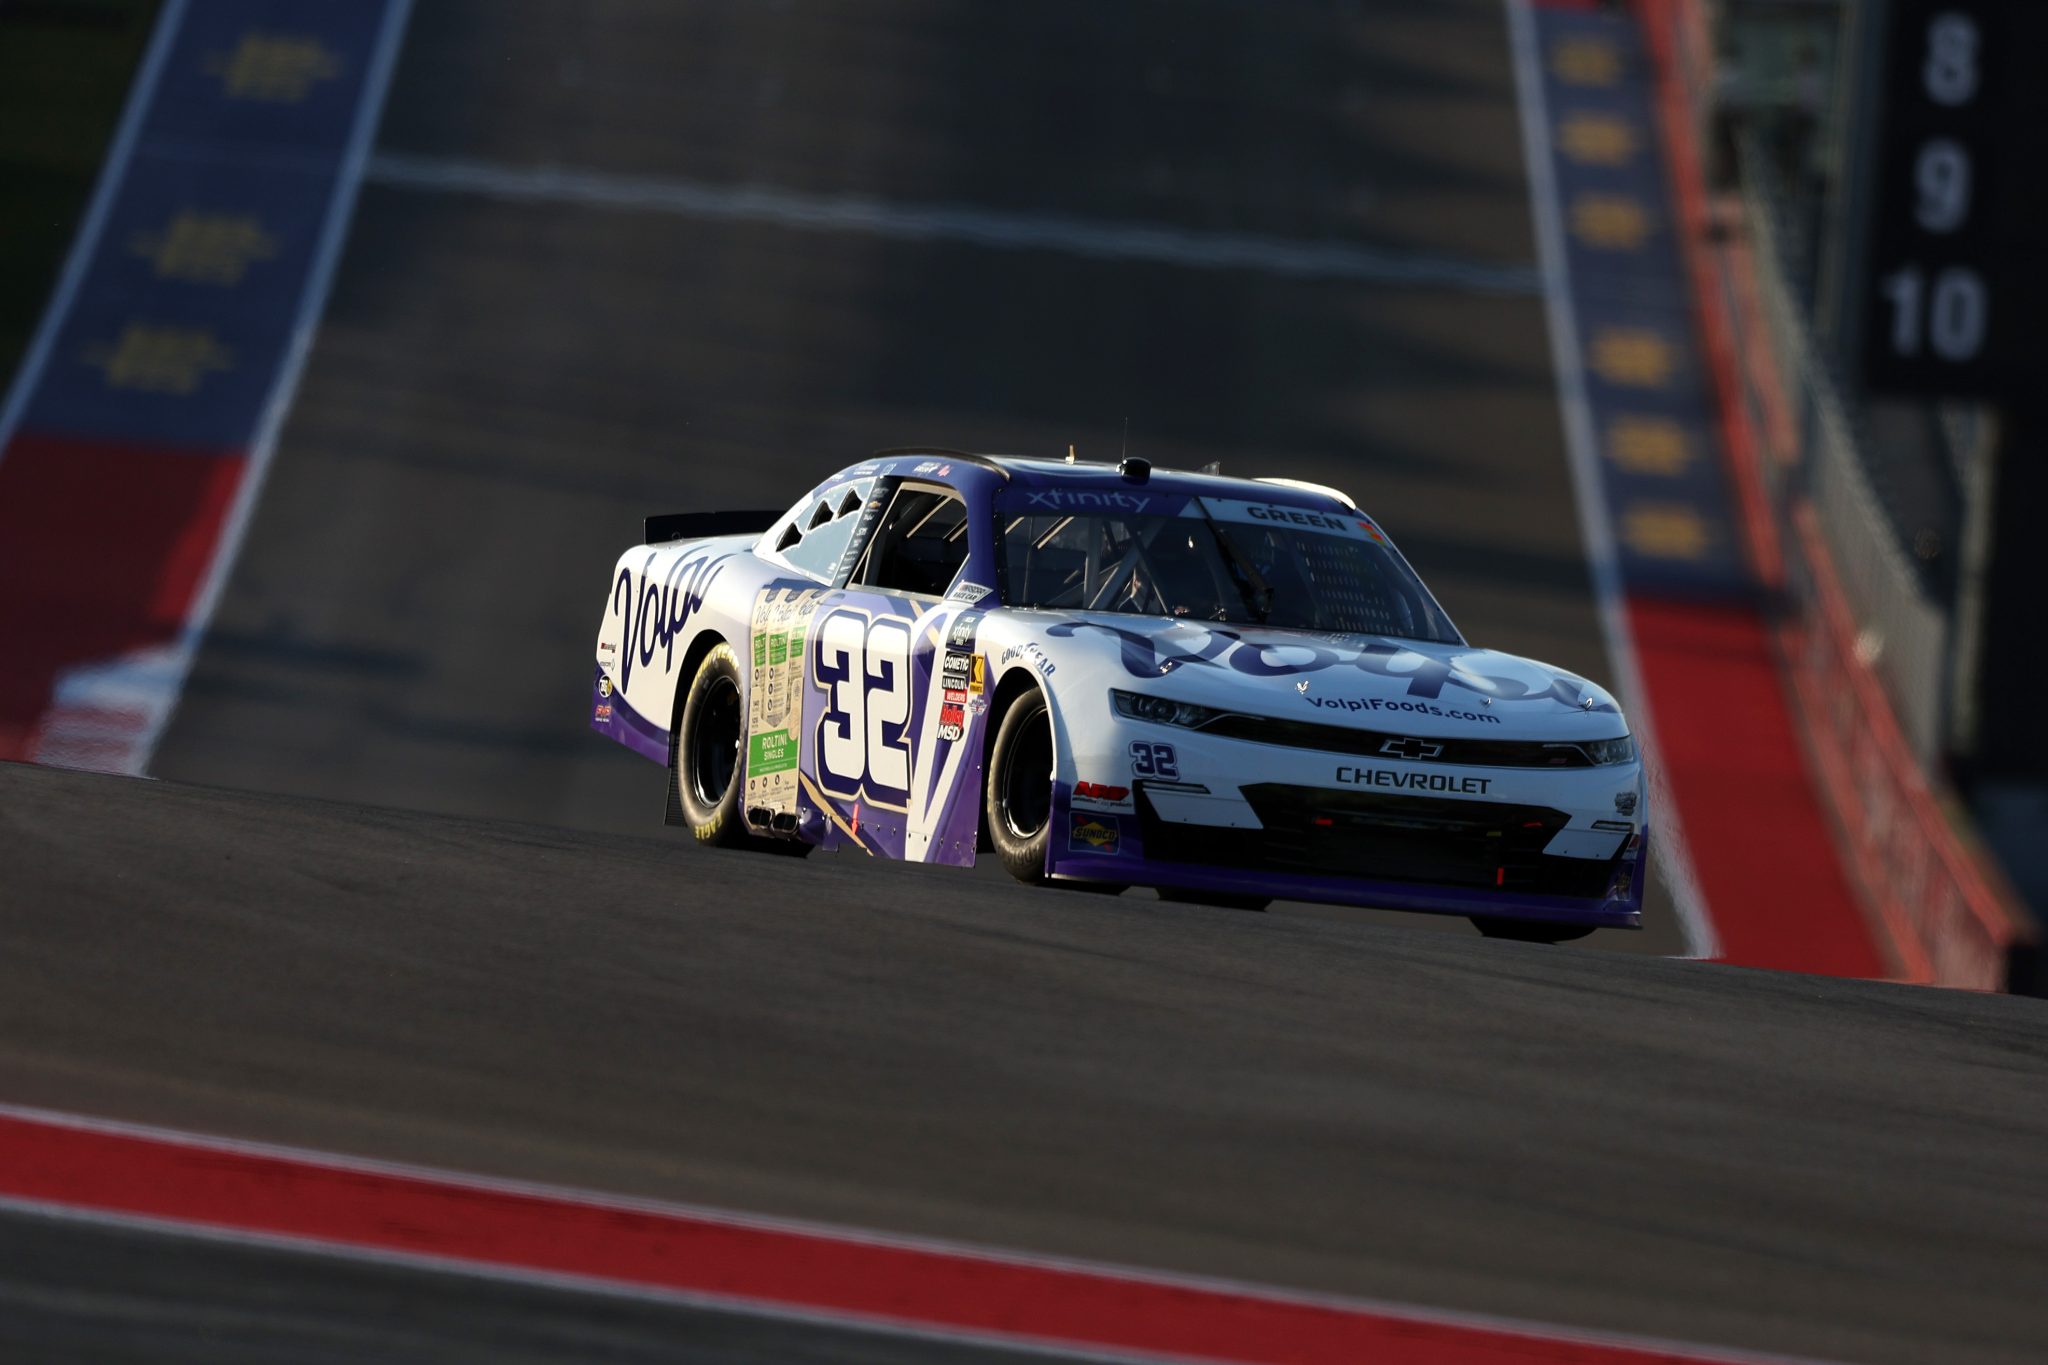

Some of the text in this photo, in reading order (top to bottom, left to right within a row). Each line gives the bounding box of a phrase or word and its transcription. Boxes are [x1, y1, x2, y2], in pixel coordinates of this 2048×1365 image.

[1922, 11, 1982, 106] 8
[1913, 139, 1972, 234] 9
[1879, 263, 1989, 362] 10
[1027, 488, 1151, 513] xfinity
[1248, 506, 1347, 531] GREEN
[944, 656, 970, 672] COMETIC
[943, 677, 966, 690] LINCOLN
[817, 609, 912, 806] 32
[1306, 696, 1502, 725] VolpiFoods.com
[762, 733, 787, 750] ROLTINI
[938, 724, 961, 741] MSD
[764, 748, 784, 761] SINGLES
[1128, 741, 1180, 781] 32
[1335, 766, 1492, 795] CHEVROLET
[1074, 826, 1117, 841] SUNOCO
